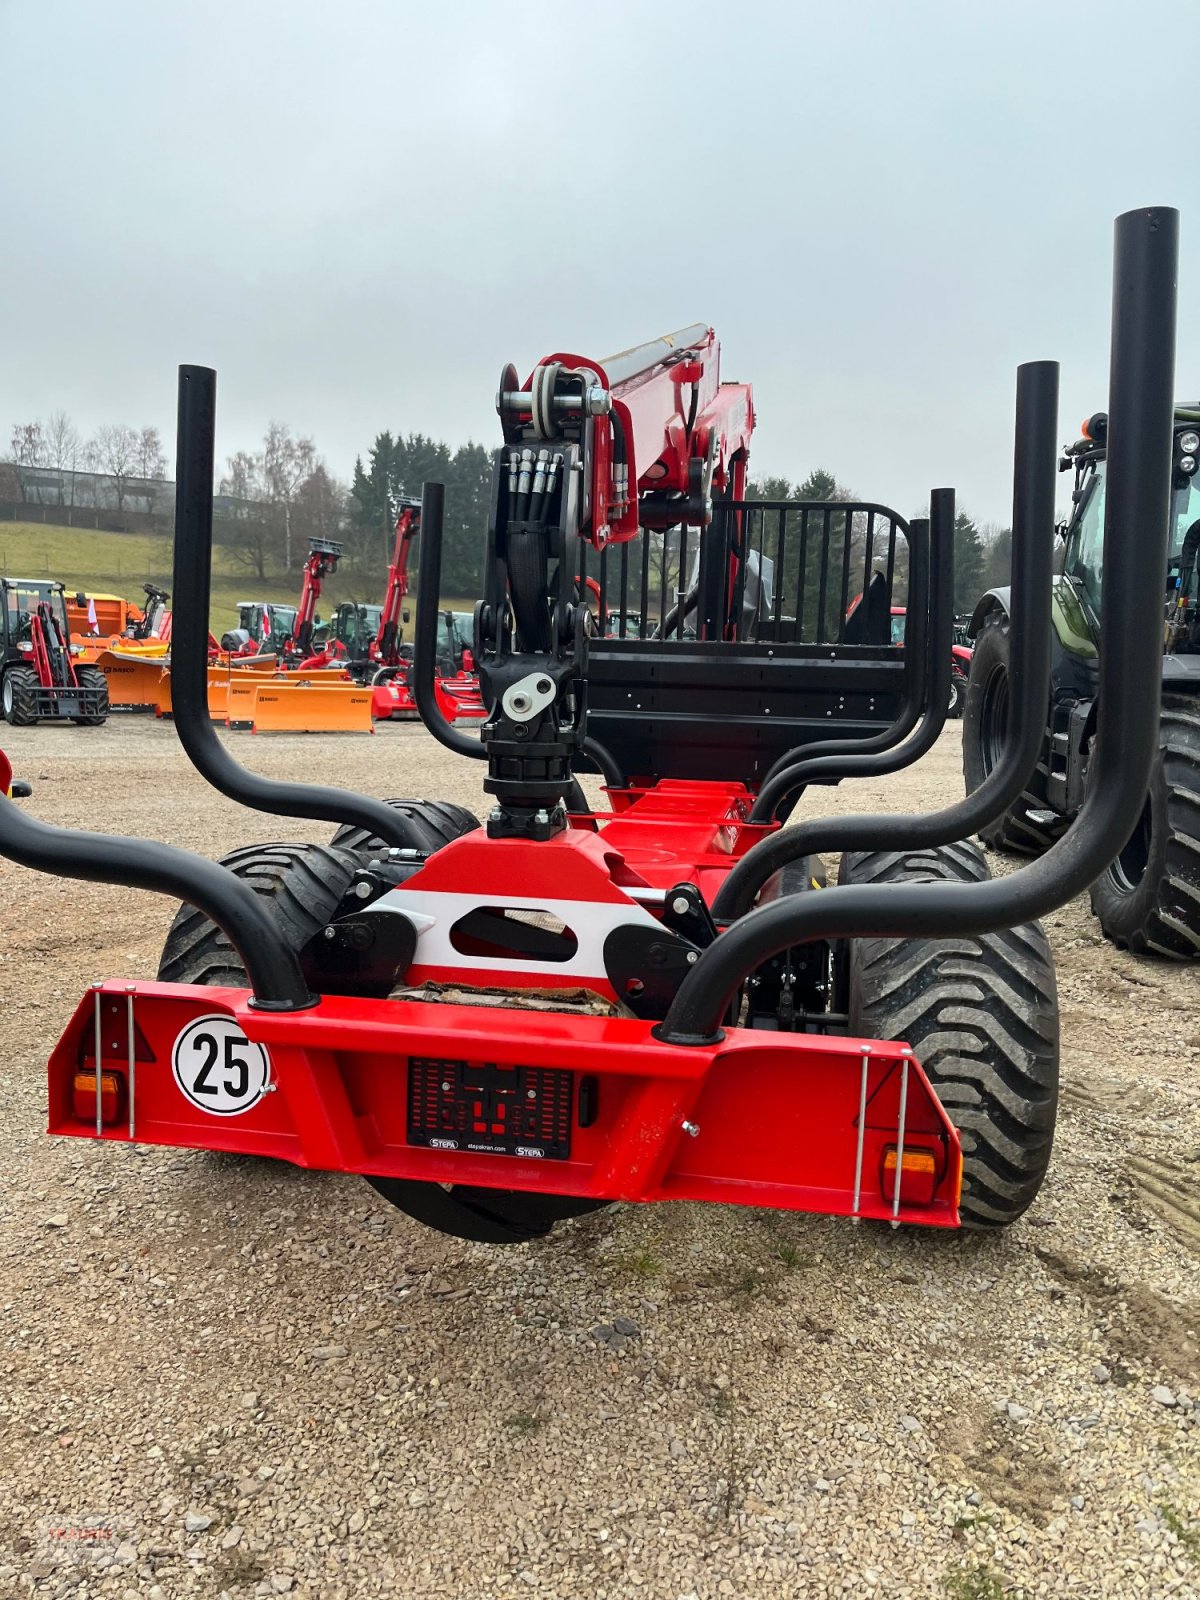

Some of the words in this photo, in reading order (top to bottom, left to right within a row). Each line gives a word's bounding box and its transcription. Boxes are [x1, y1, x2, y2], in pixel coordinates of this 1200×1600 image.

[193, 1033, 249, 1097] 25
[431, 1139, 456, 1149] STEPA
[467, 1143, 507, 1152] stepakran.com
[516, 1147, 543, 1157] STEPA
